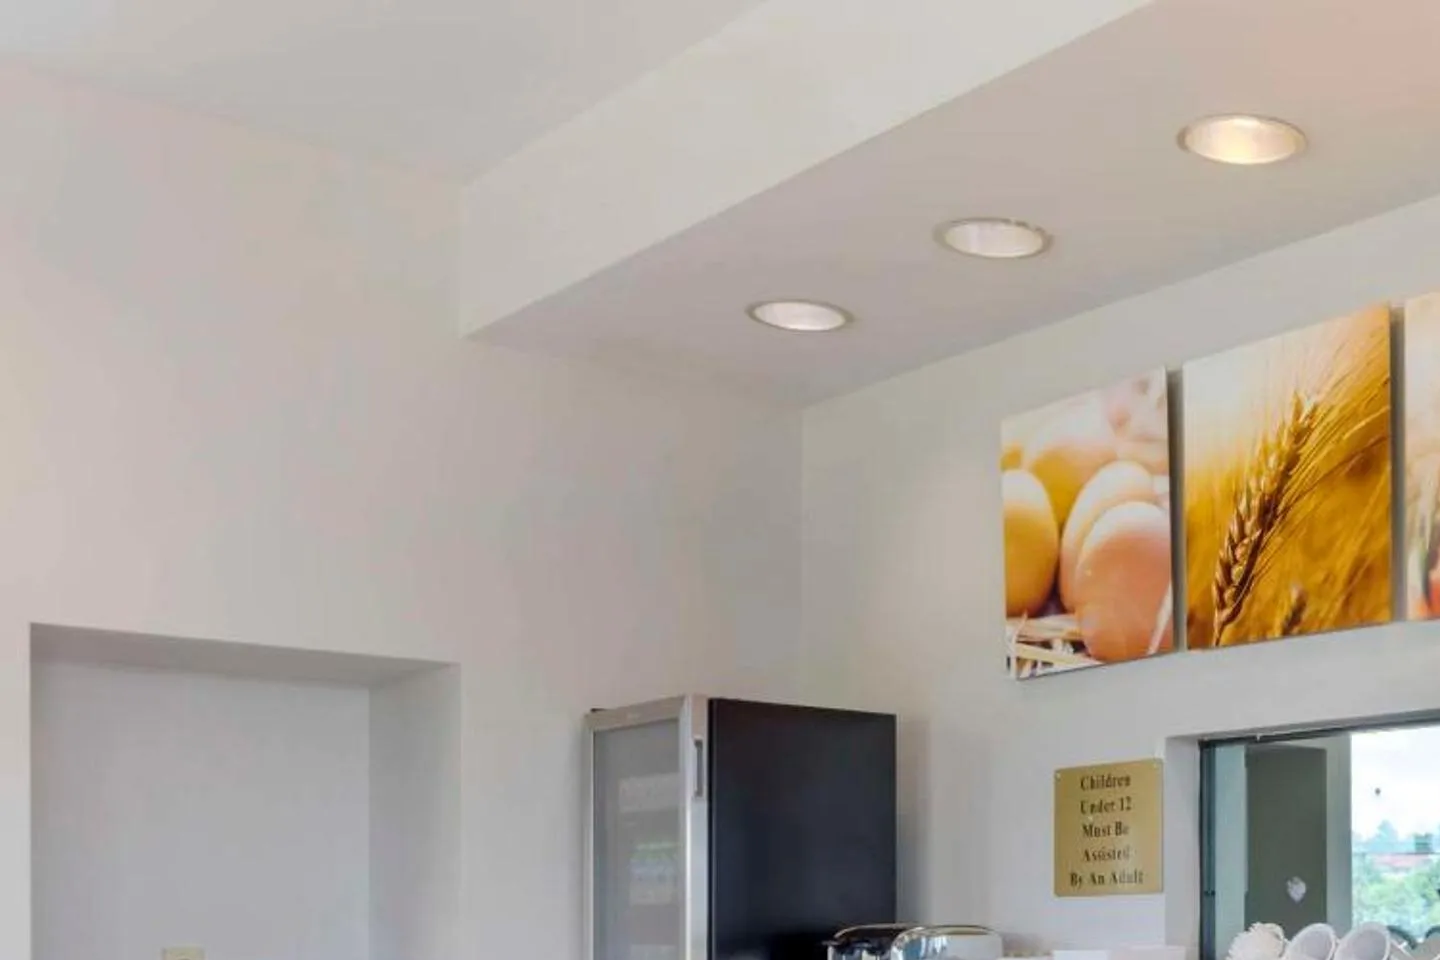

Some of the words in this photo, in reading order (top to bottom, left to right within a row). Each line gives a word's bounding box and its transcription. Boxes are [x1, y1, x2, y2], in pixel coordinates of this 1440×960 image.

[1080, 773, 1131, 791] Children
[1080, 799, 1116, 815] Under
[1119, 796, 1132, 811] 12
[1082, 823, 1111, 838] Must
[1115, 821, 1130, 836] Be
[1083, 845, 1131, 862] Assisted
[1070, 873, 1082, 889] By
[1090, 873, 1105, 885] An
[1110, 870, 1144, 884] Adult
